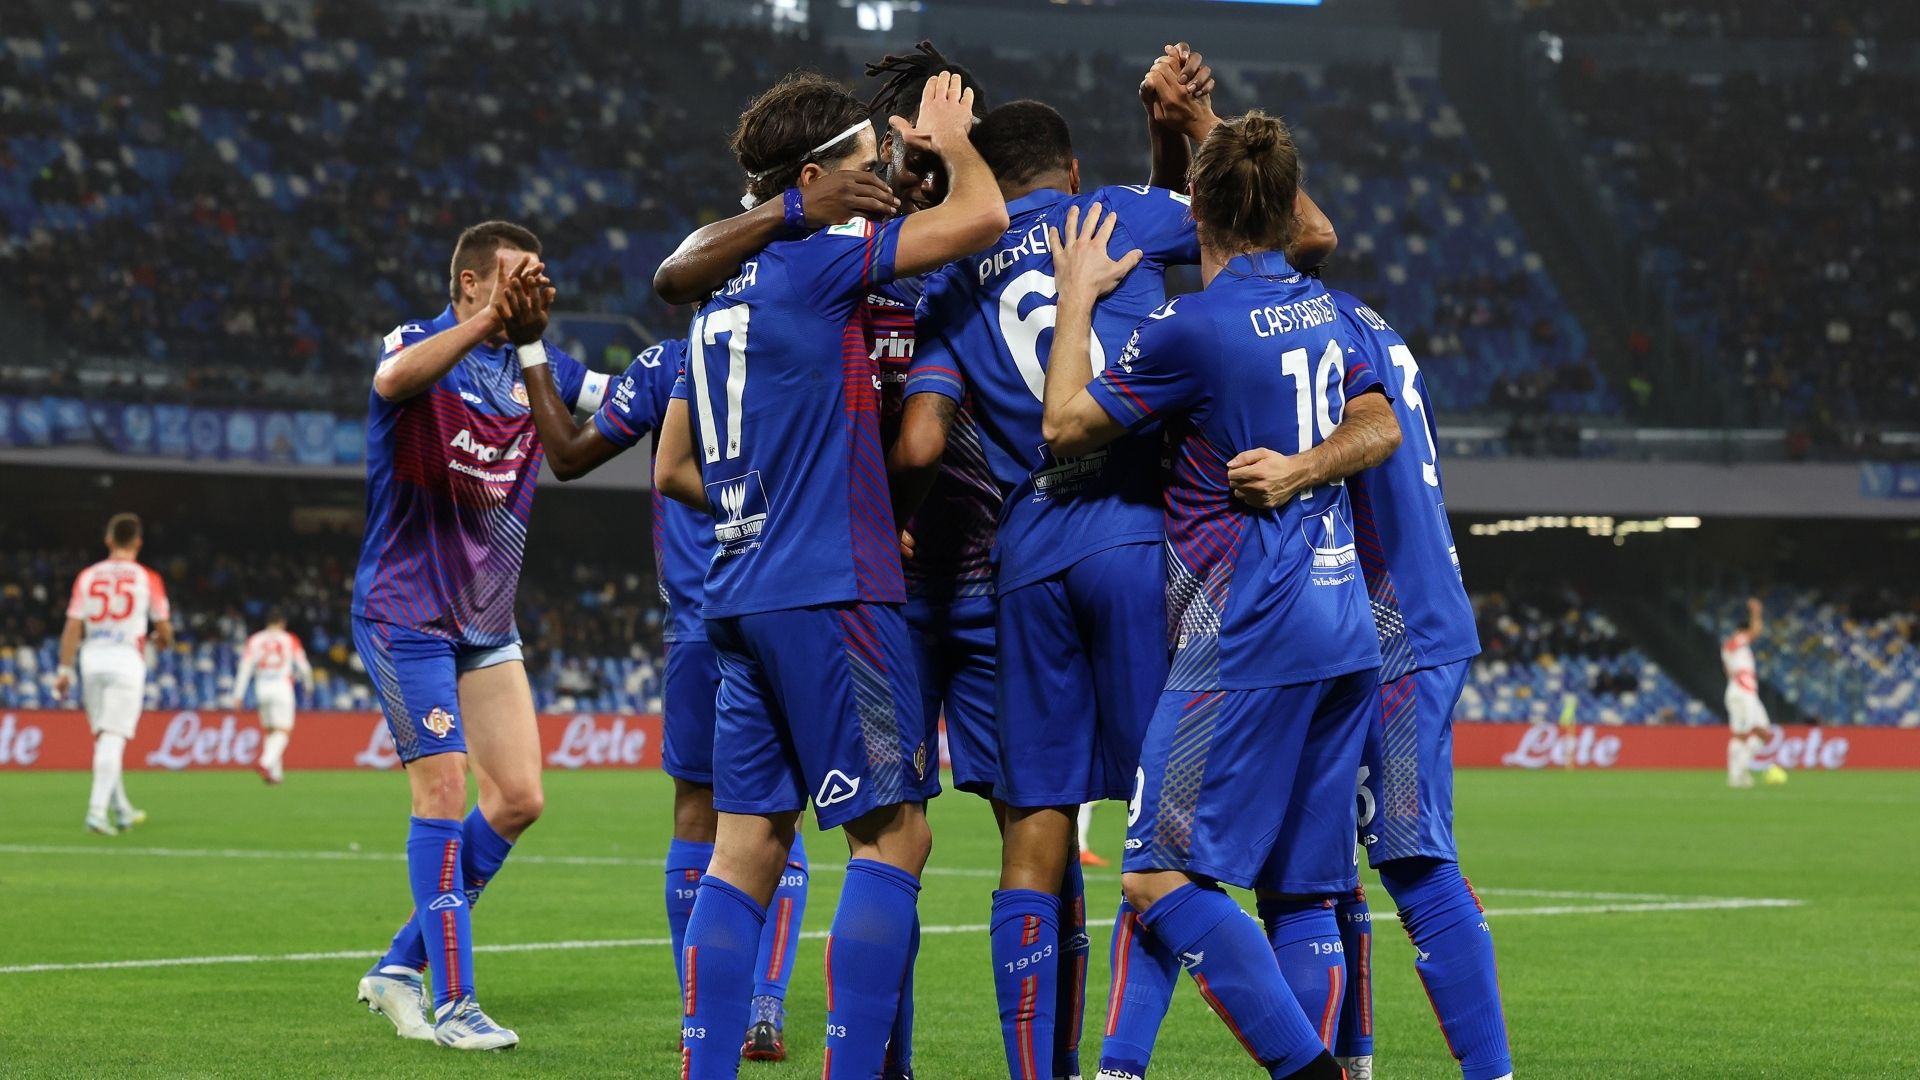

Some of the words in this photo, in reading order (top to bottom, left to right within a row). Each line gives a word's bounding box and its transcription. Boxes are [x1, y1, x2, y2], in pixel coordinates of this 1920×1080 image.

[980, 222, 1050, 285] PICKEL
[999, 269, 1106, 403] 6
[692, 304, 750, 464] 17
[89, 577, 134, 623] 55
[146, 712, 260, 769] Lete
[547, 715, 646, 768] Lete
[1502, 724, 1622, 769] Lete
[1005, 945, 1053, 974] 1903
